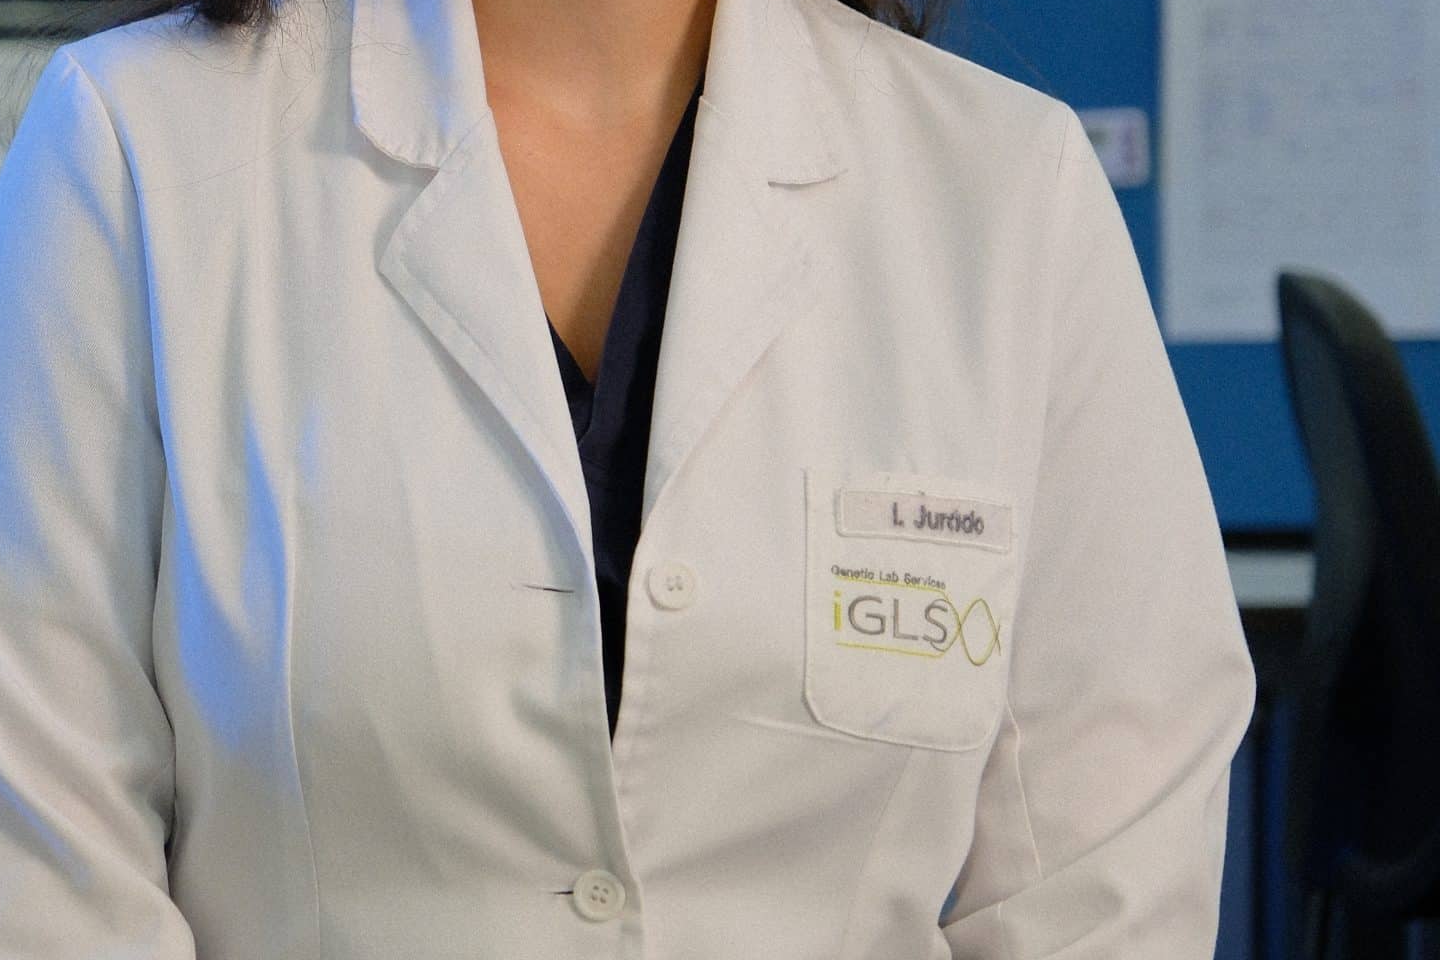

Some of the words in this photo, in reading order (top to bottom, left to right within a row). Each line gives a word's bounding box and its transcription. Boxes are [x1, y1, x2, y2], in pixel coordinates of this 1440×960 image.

[831, 564, 875, 581] Genetic
[879, 570, 899, 583] Lab
[903, 572, 946, 589] Services
[833, 590, 949, 644] iGLS
